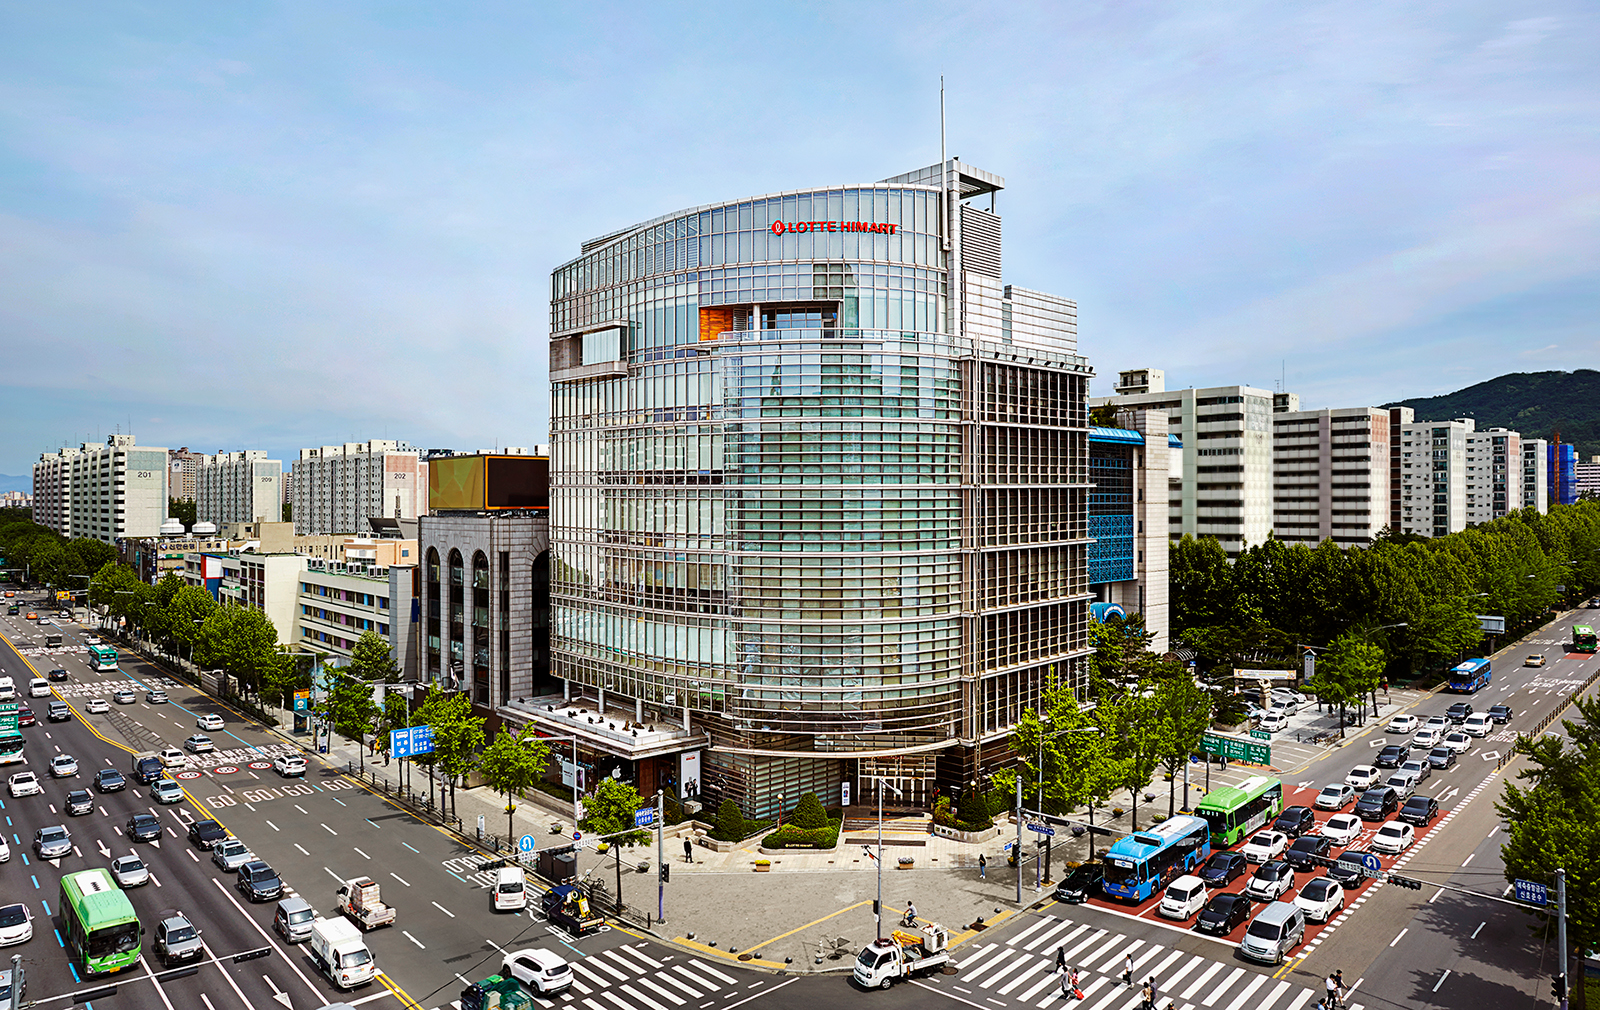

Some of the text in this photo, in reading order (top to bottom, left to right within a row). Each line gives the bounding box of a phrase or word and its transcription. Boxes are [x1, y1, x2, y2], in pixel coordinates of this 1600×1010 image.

[788, 221, 898, 235] LOTTE HIMART
[137, 471, 152, 479] 201
[206, 779, 353, 809] 60 60 60 60
[1201, 809, 1219, 817] 3011
[1517, 881, 1546, 894] 예측출발금지
[1520, 891, 1542, 902] 신호준수
